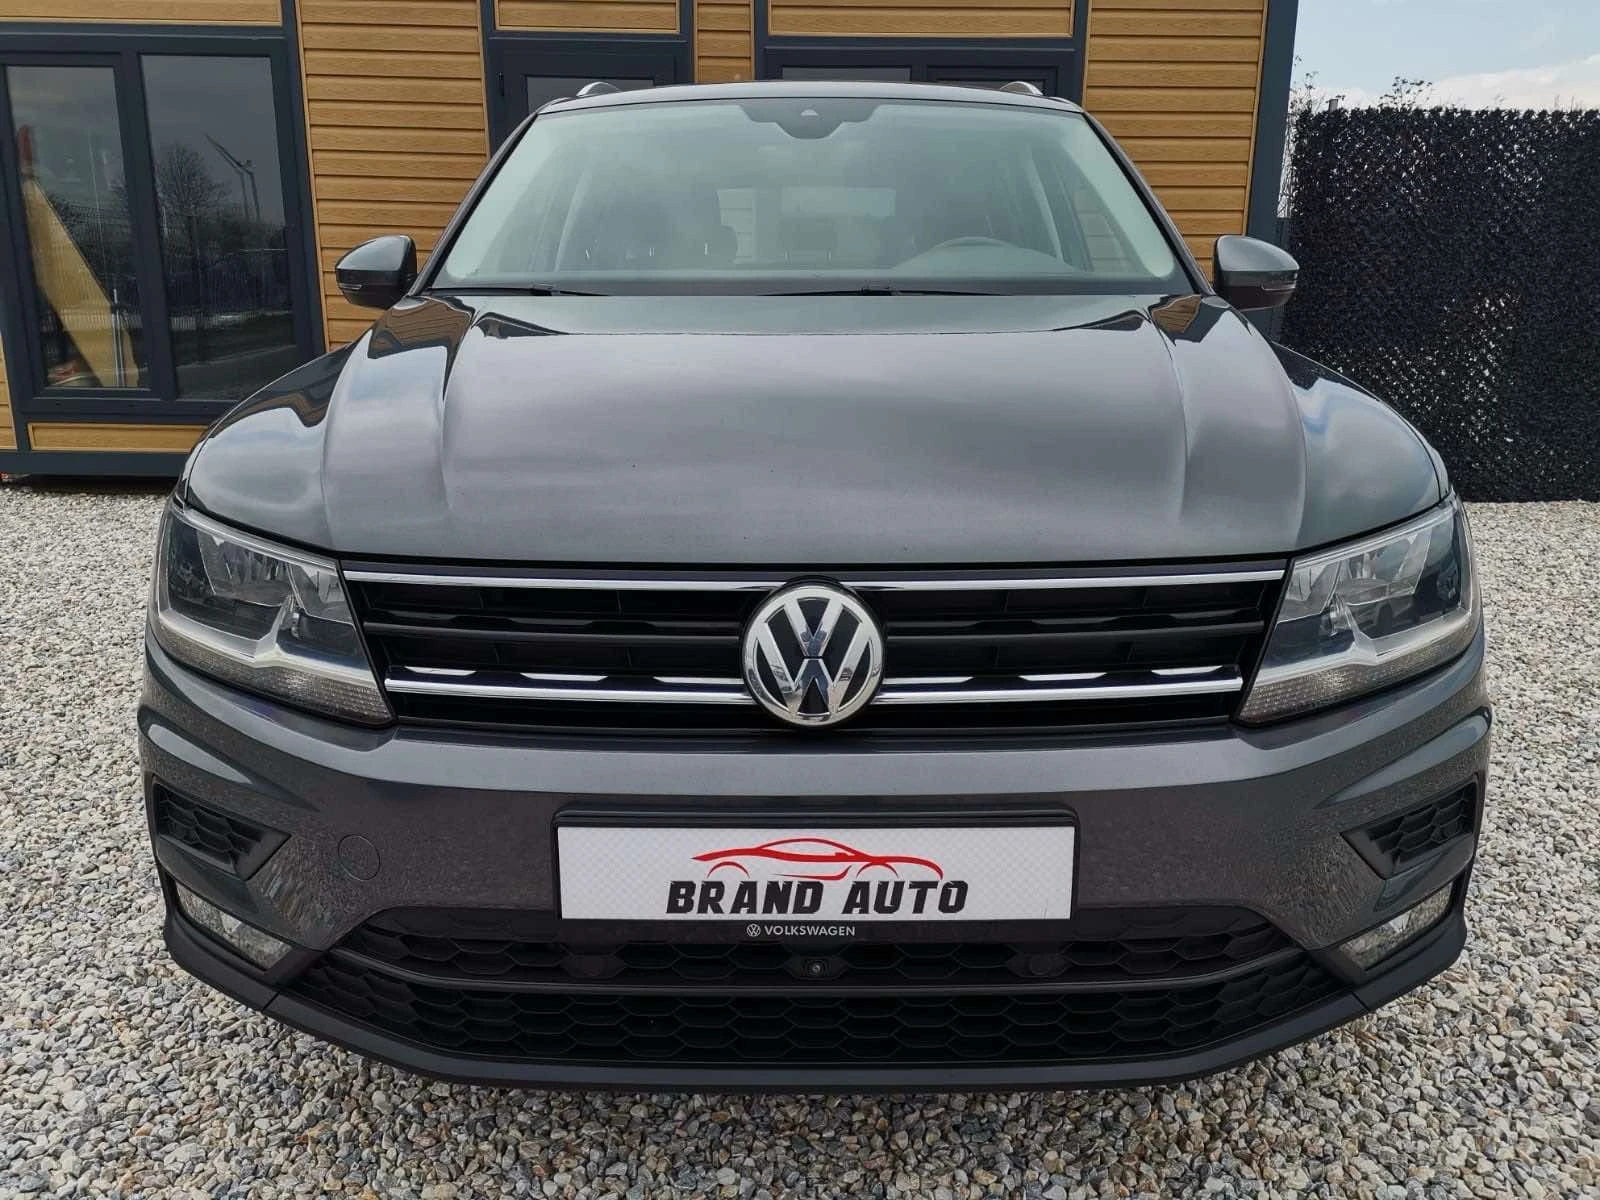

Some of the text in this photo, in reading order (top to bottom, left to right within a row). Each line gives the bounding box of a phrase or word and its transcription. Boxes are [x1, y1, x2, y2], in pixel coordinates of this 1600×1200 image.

[665, 880, 968, 914] BRAND AUTO
[764, 925, 856, 937] VOLKSWAGEN
